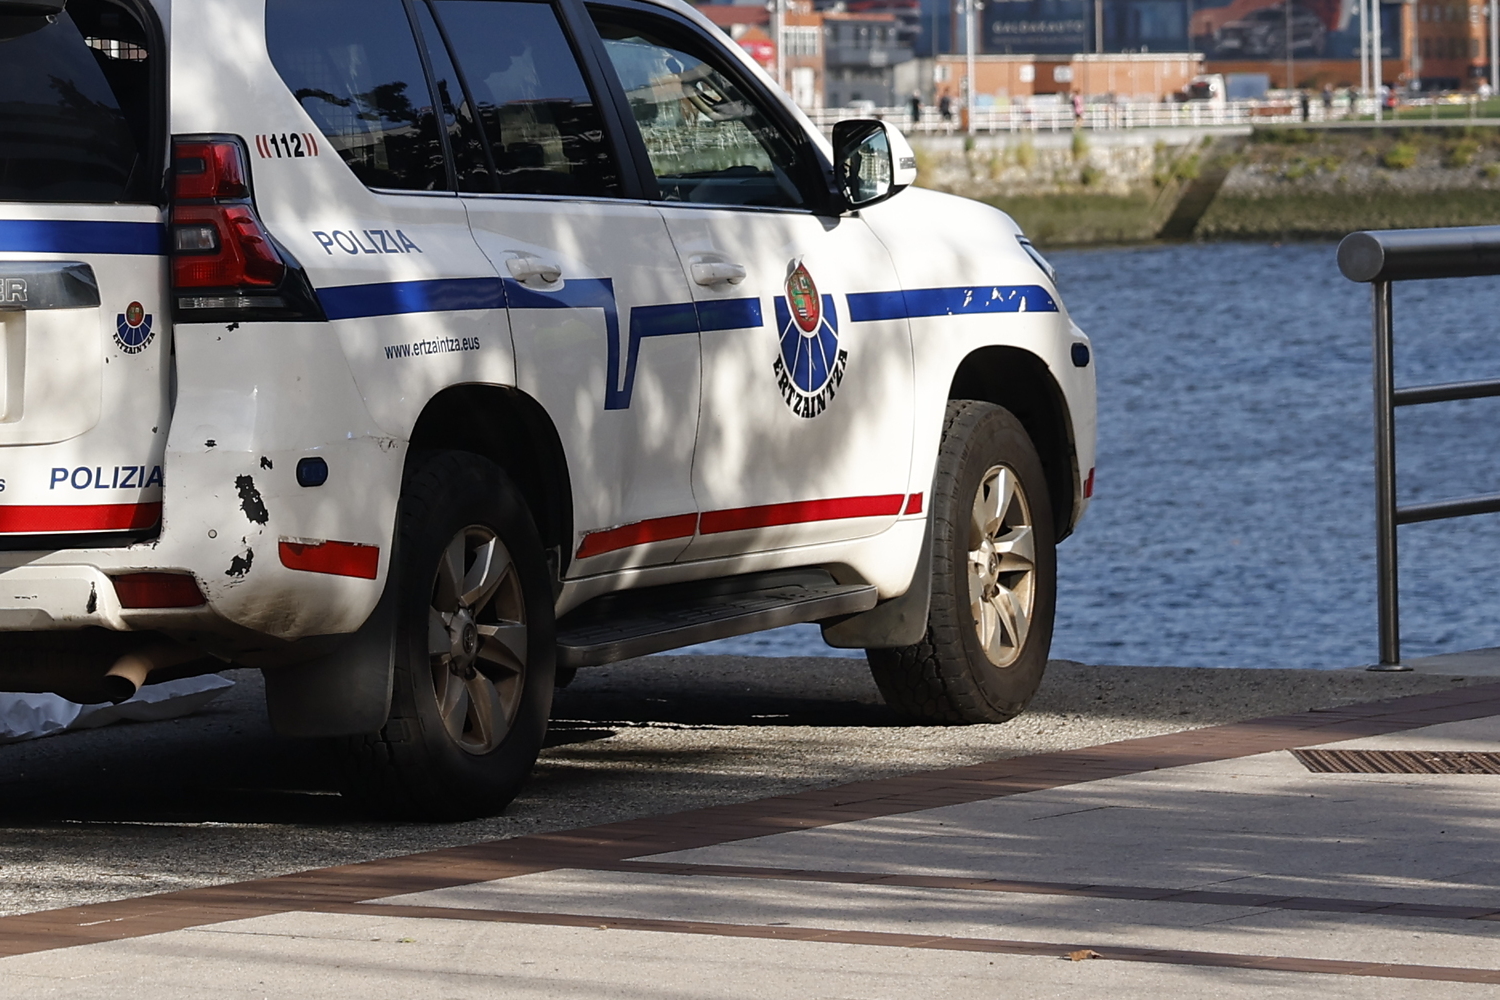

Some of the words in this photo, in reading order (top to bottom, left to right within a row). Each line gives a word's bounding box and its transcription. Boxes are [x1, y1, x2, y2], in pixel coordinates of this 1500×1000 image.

[312, 230, 423, 255] POLIZIA
[113, 332, 156, 354] ERTZAINTZA
[384, 336, 480, 359] www.ertzaintza.eus
[773, 349, 848, 418] ERTZAINTZA
[49, 465, 164, 490] POLIZIA
